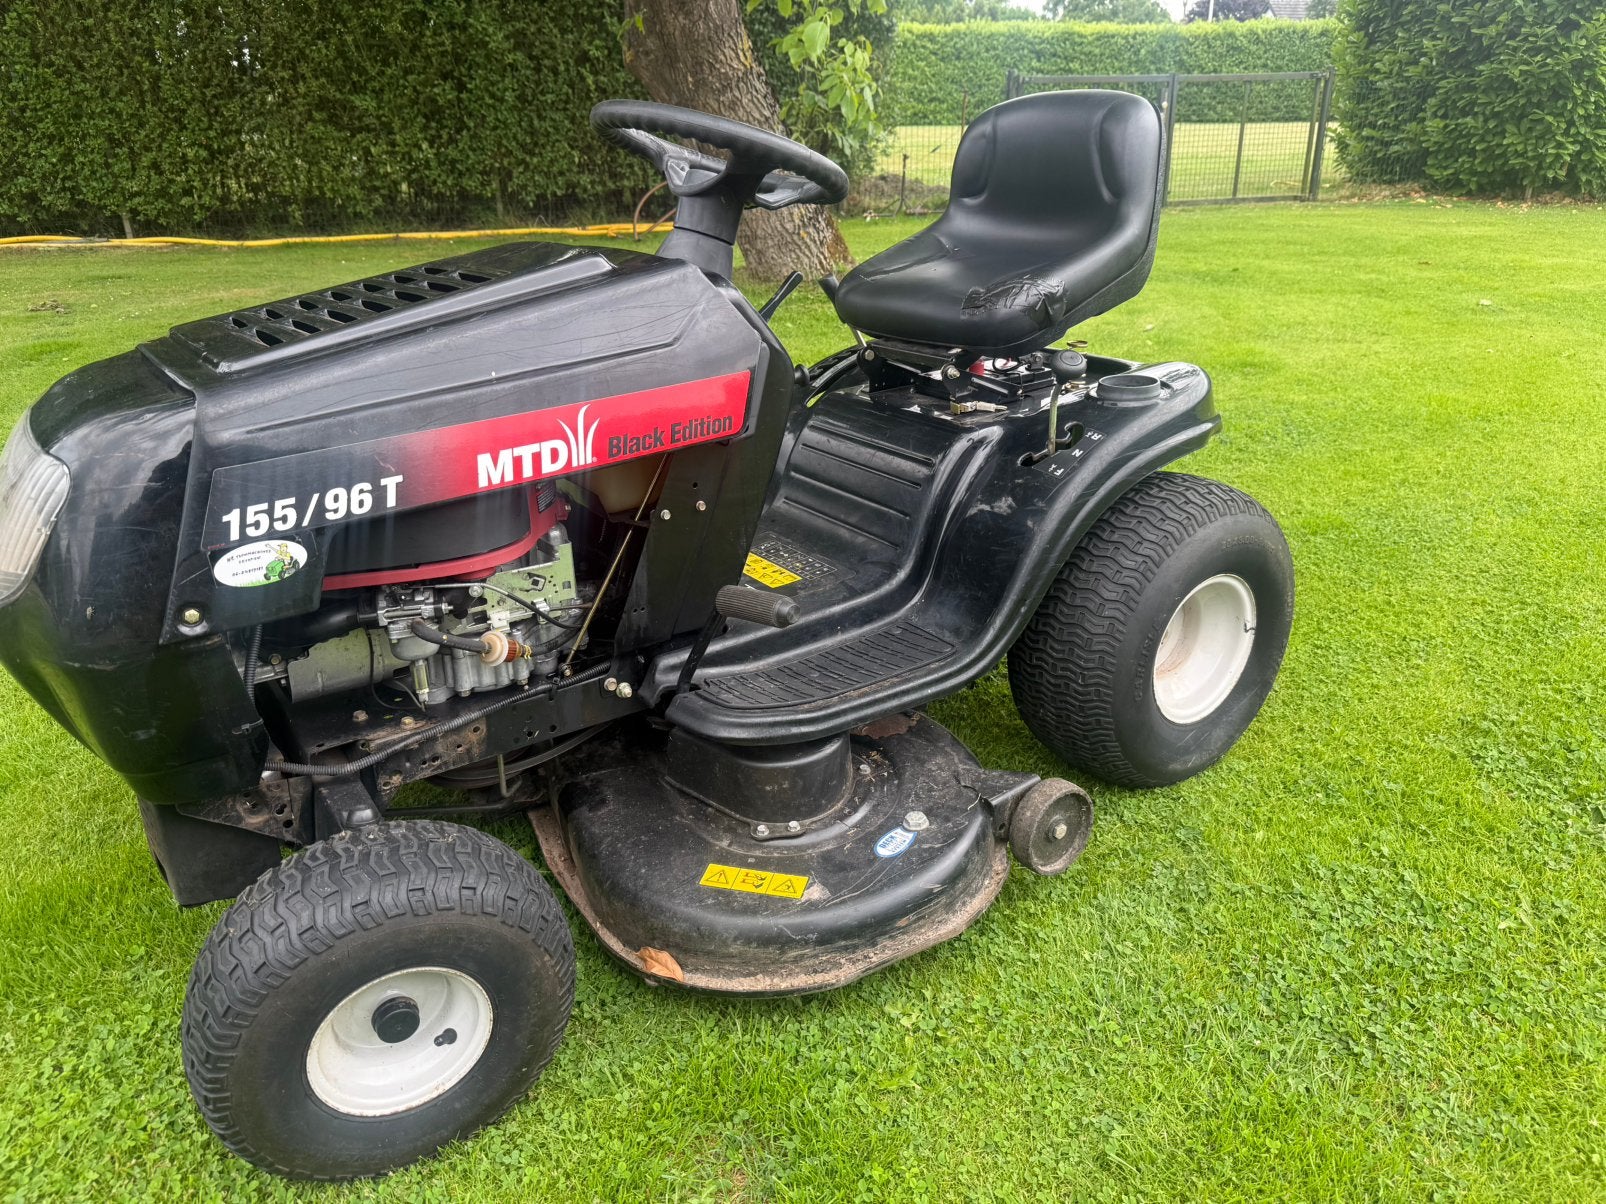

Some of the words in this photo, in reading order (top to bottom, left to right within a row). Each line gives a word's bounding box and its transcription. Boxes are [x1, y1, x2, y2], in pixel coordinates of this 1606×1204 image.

[608, 427, 665, 459] Black
[670, 415, 733, 444] Edition
[477, 439, 569, 488] MTD
[222, 482, 373, 541] 155/96
[380, 474, 404, 508] T
